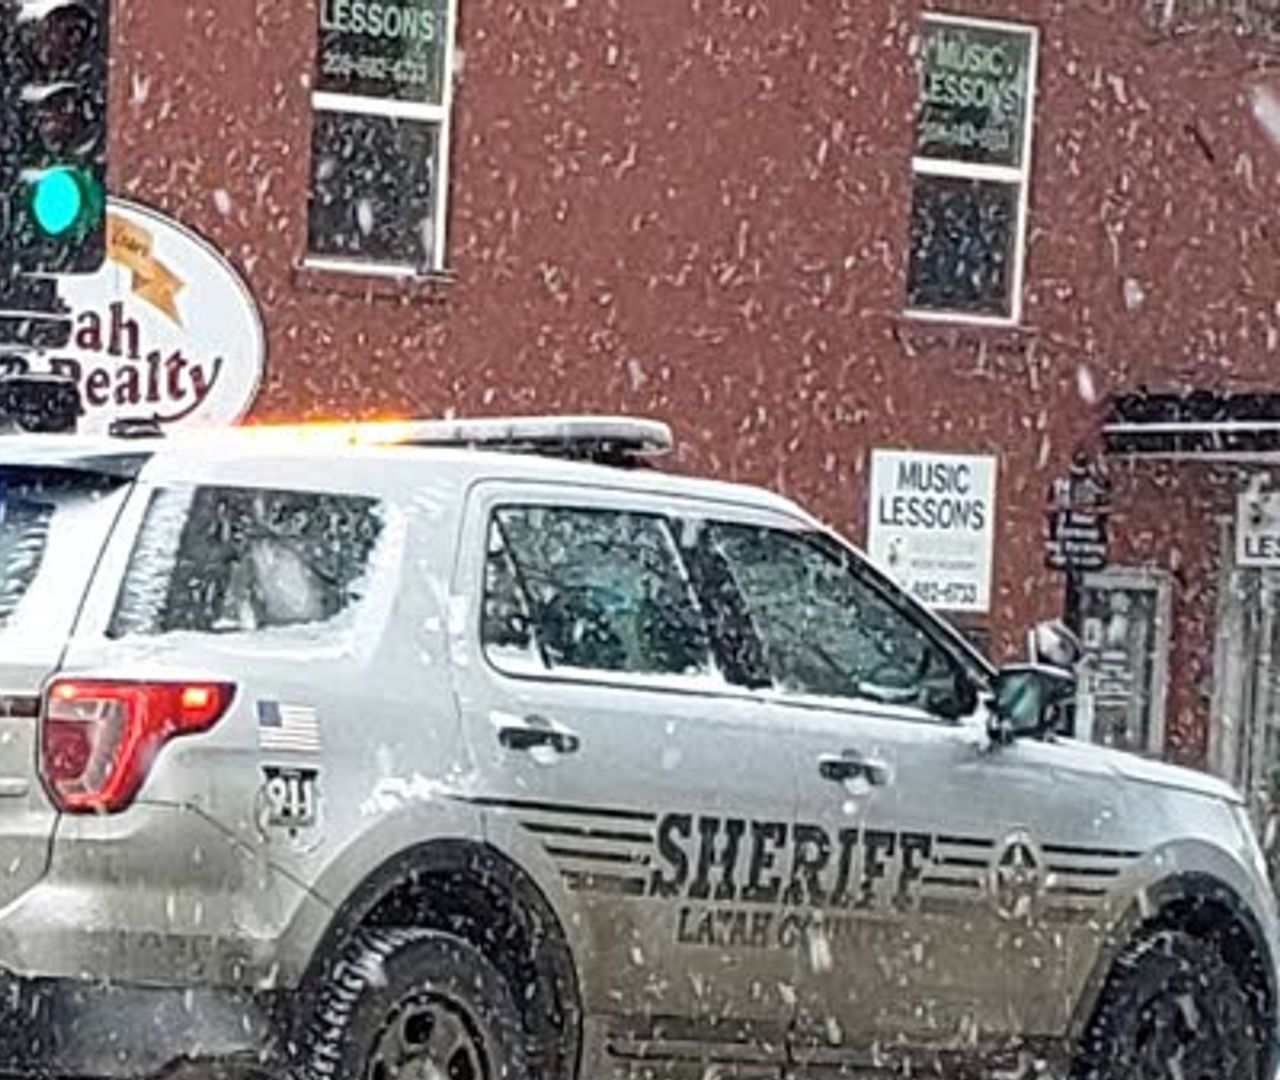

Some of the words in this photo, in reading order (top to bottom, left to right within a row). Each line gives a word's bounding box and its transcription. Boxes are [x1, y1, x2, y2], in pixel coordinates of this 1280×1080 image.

[321, 0, 434, 41] LESSONS
[897, 462, 971, 494] MUSIC
[879, 497, 986, 531] LESSONS
[268, 777, 313, 818] 911
[649, 813, 933, 911] SHERIFF
